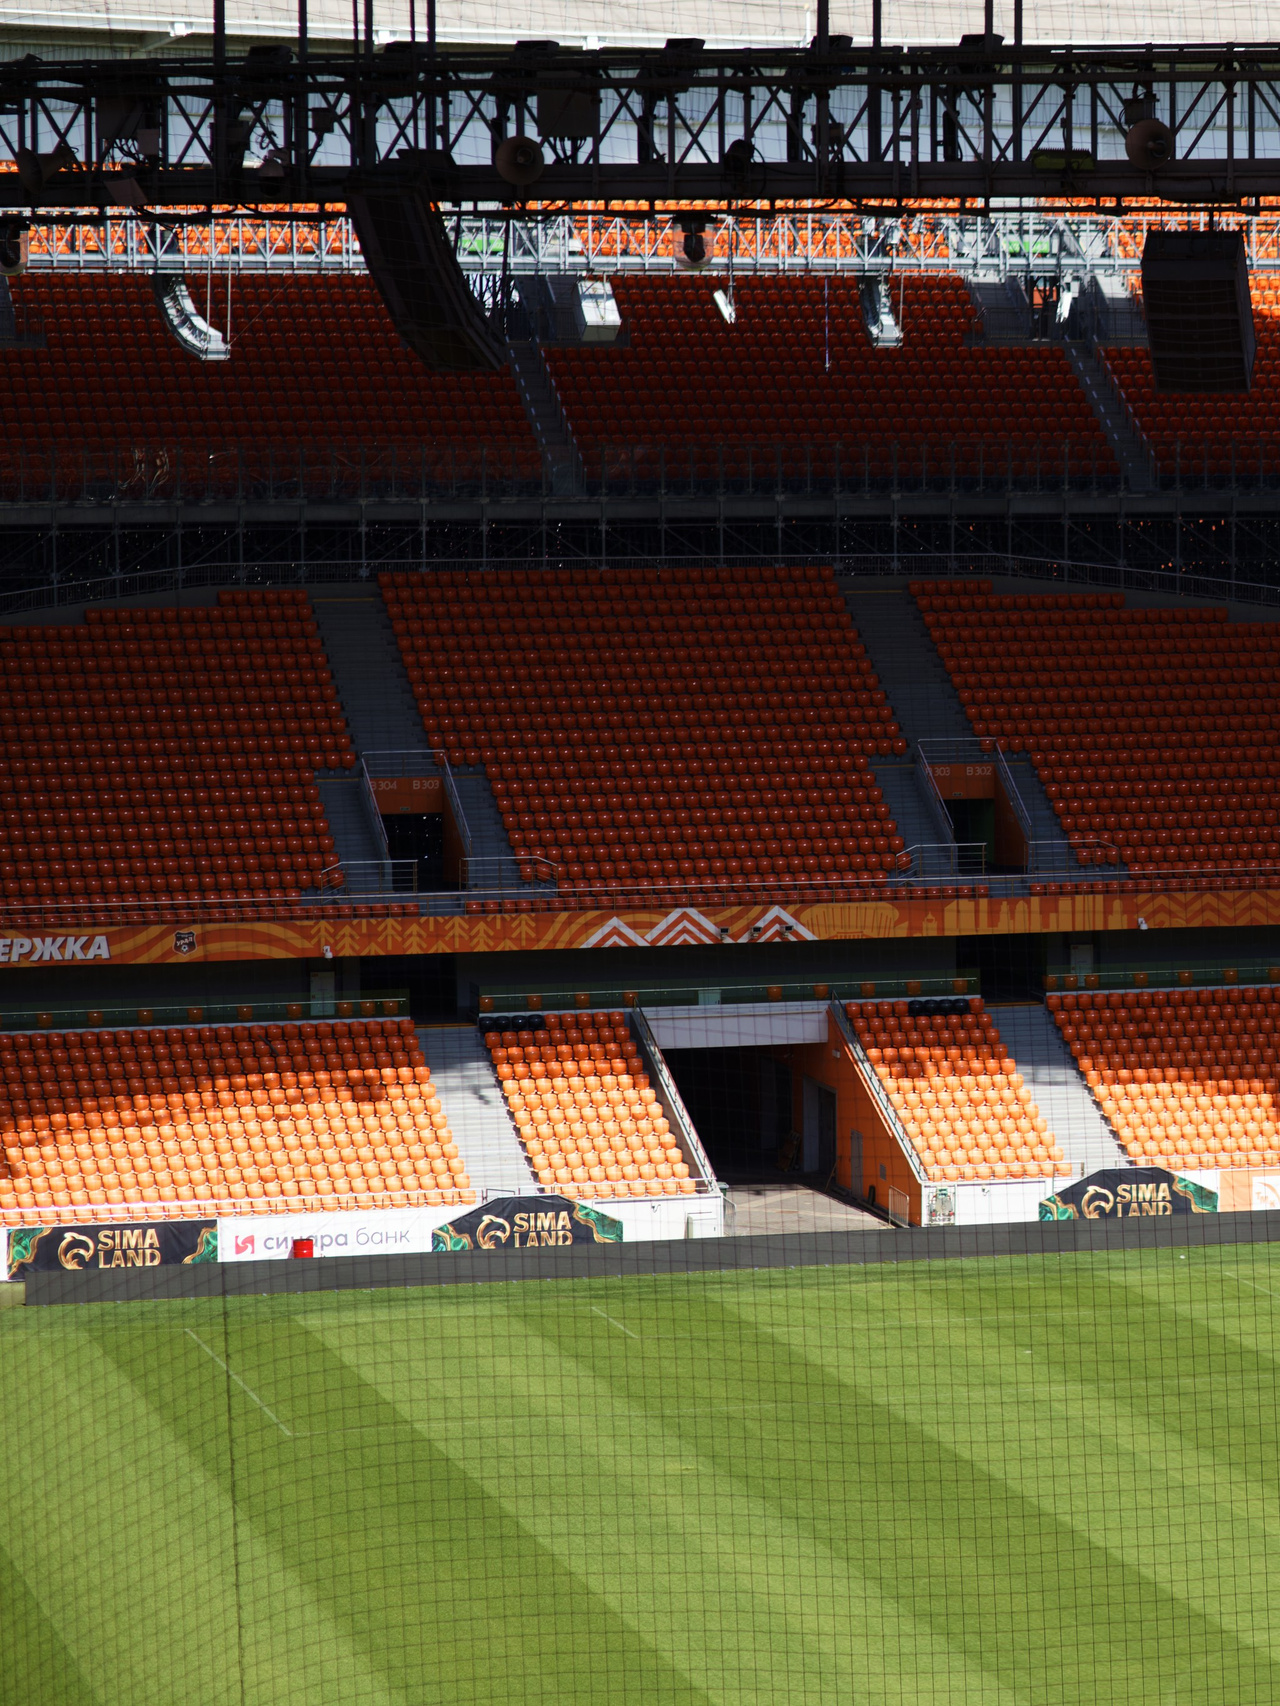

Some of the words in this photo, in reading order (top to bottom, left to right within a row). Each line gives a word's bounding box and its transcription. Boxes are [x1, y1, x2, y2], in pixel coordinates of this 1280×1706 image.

[0, 935, 111, 962] ЕРЖКА
[1116, 1182, 1173, 1204] SIMA
[513, 1211, 572, 1233] SIMA
[97, 1228, 160, 1251] SIMA
[356, 1226, 411, 1246] банк
[514, 1230, 573, 1248] LAND
[98, 1248, 161, 1269] LAND
